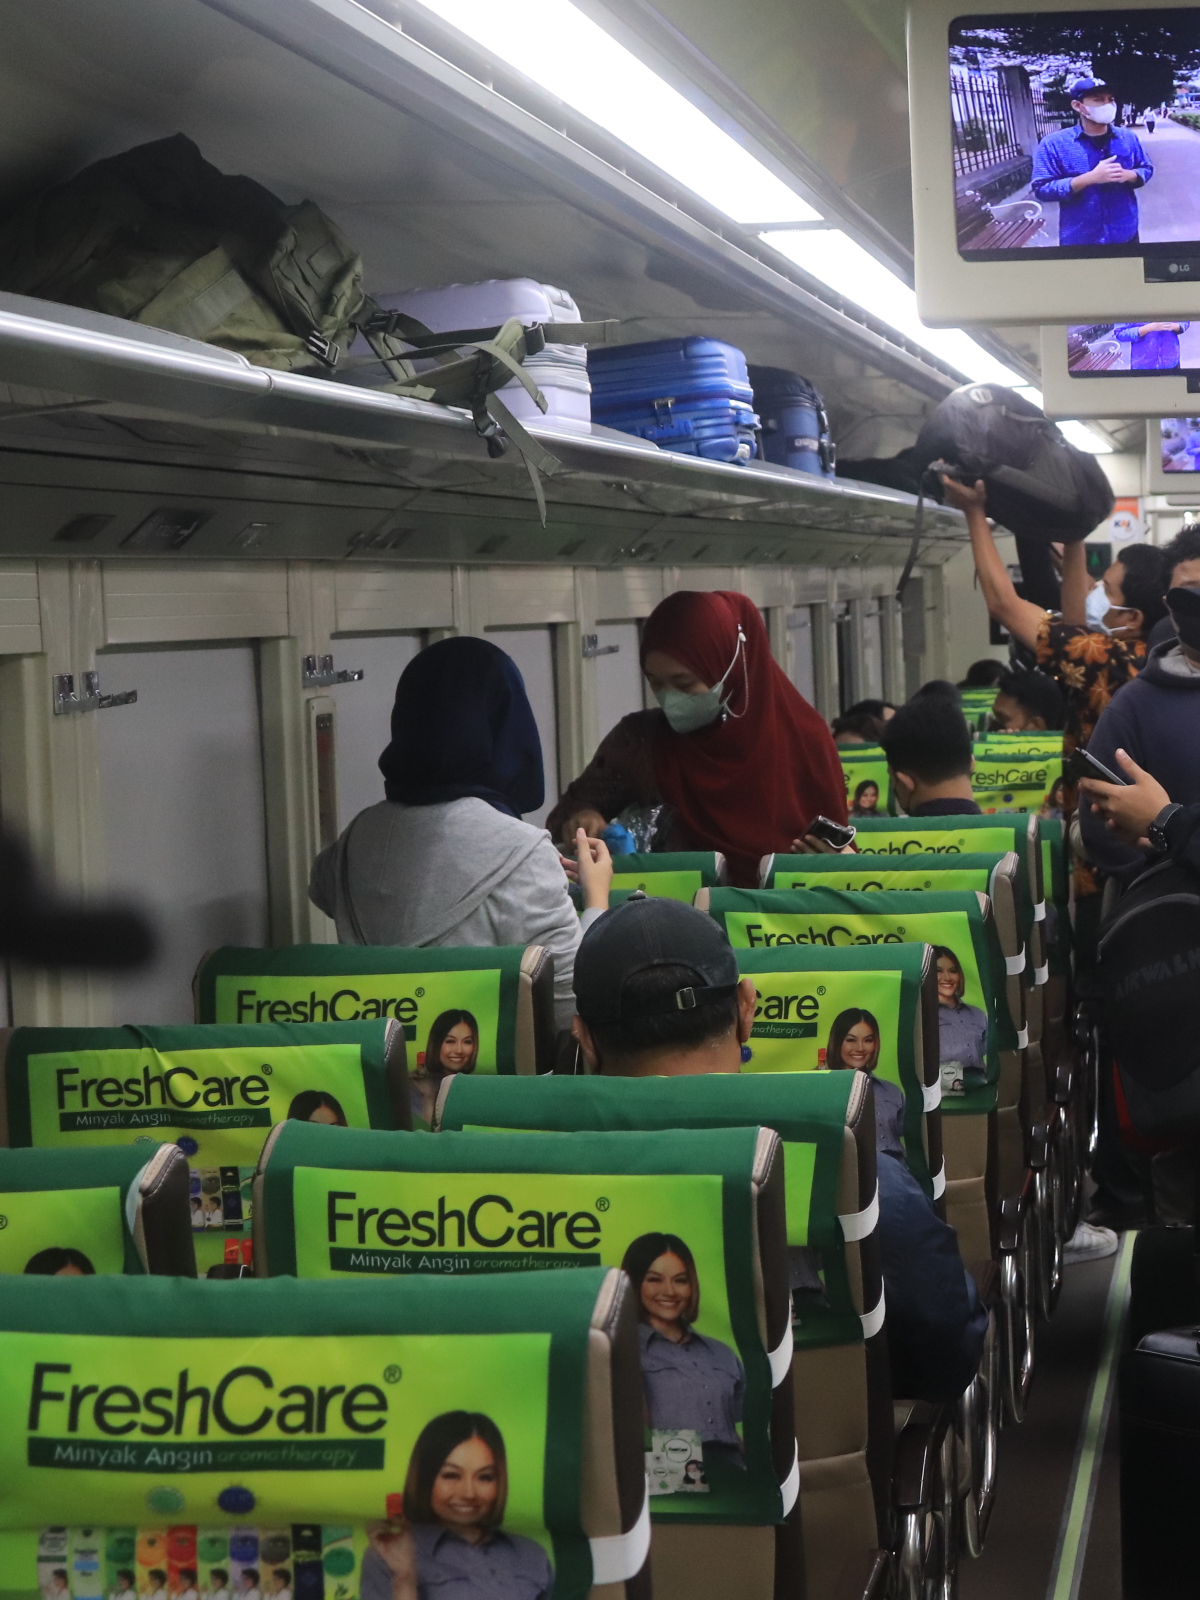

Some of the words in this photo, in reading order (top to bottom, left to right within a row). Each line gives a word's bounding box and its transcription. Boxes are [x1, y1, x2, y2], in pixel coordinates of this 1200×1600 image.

[1179, 264, 1190, 272] LG
[76, 1111, 125, 1127] Minyak
[129, 1111, 171, 1126] Angin
[173, 1113, 255, 1126] aromatherapy
[350, 1253, 412, 1270] Minyak
[418, 1255, 470, 1272] Angin
[473, 1255, 581, 1269] aromatherapy
[54, 1443, 137, 1466] Minyak
[144, 1446, 213, 1470] Angin
[217, 1445, 357, 1467] aromatherapy
